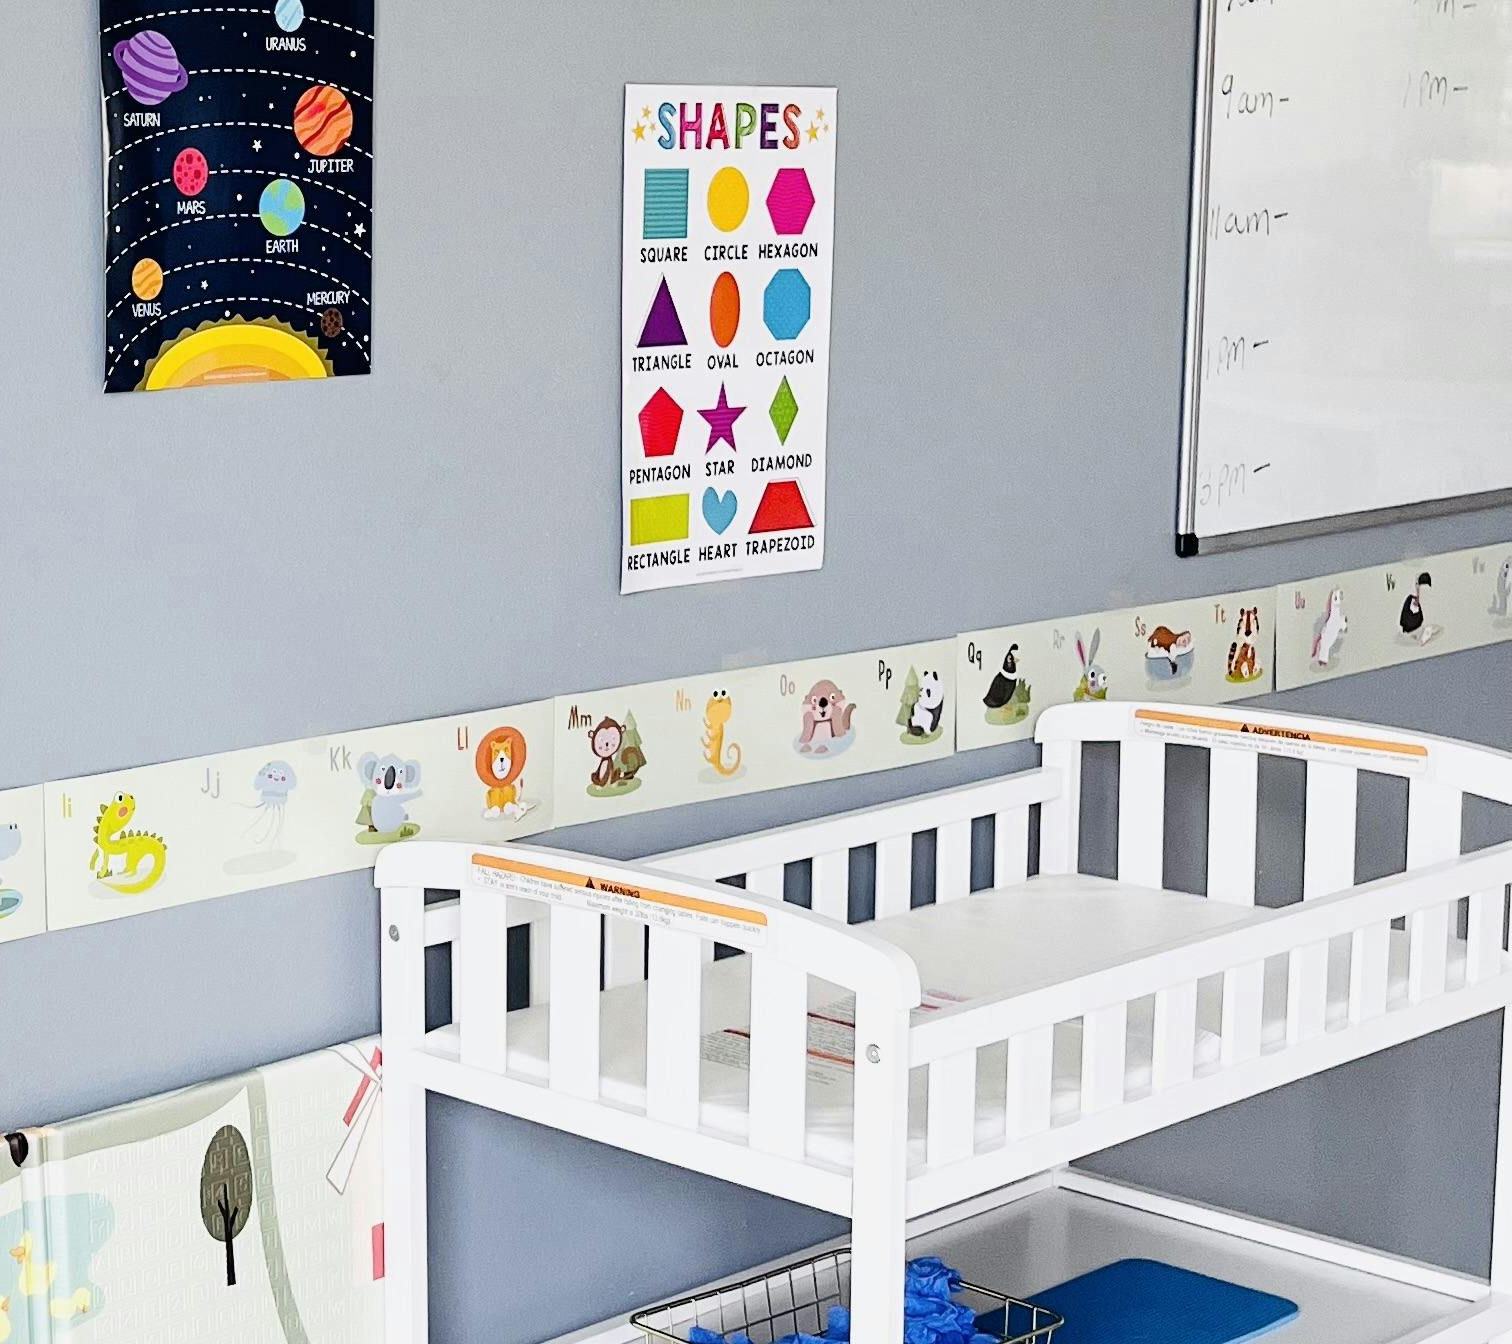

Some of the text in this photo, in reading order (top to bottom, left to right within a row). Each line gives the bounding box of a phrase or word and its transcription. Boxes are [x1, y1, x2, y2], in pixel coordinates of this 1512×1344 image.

[266, 36, 306, 52] URANUS
[124, 112, 160, 128] SATURN
[658, 102, 802, 149] SHAPES
[308, 159, 354, 173] JUPITER
[177, 200, 206, 214] MARS
[266, 240, 298, 254] EARTH
[640, 247, 688, 263] SQUARE
[704, 244, 748, 260] CIRCLE
[758, 243, 818, 258] HEXAGON
[307, 290, 350, 306] MERCURY
[132, 303, 162, 316] VENUS
[633, 353, 691, 372] TRIANGLE
[707, 354, 738, 370] OVAL
[756, 349, 814, 366] OCTAGON
[706, 460, 734, 476] STAR
[751, 453, 812, 472] DIAMOND
[629, 464, 691, 484] PENTAGON
[699, 543, 737, 561] HEART
[746, 535, 815, 556] TRAPEZOID
[628, 548, 690, 571] RECTANGLE
[967, 642, 982, 670] Qq
[878, 659, 892, 690] Pp
[779, 674, 795, 696] Oo
[676, 688, 691, 712] Nn
[568, 705, 592, 730] Mm
[1253, 727, 1310, 740] ADVERTENCIA
[329, 745, 352, 771] Kk
[200, 768, 220, 799] Jj
[600, 882, 640, 899] WARNING
